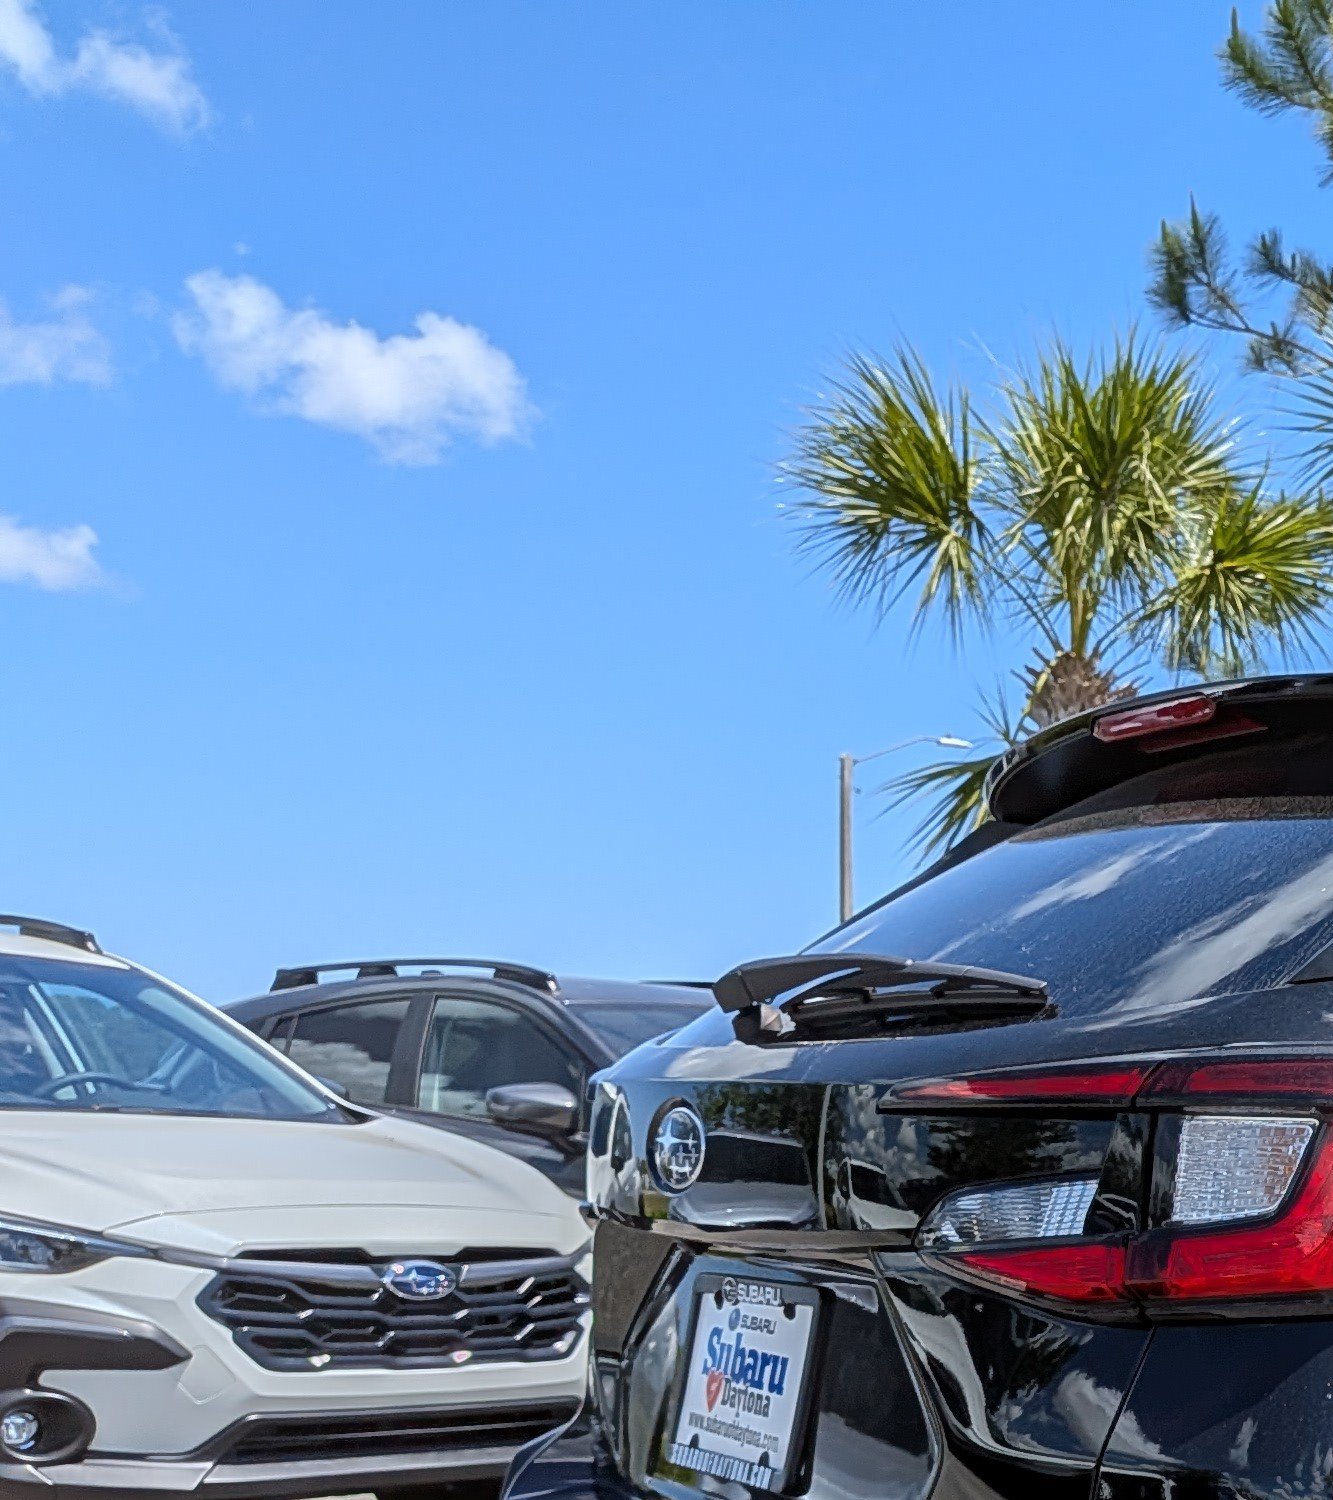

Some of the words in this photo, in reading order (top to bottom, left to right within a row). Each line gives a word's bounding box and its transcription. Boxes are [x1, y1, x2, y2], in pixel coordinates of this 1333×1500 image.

[736, 1283, 782, 1305] SUBARU
[739, 1316, 777, 1335] SUBARU
[702, 1326, 790, 1396] Subaru
[721, 1377, 771, 1418] Daytona
